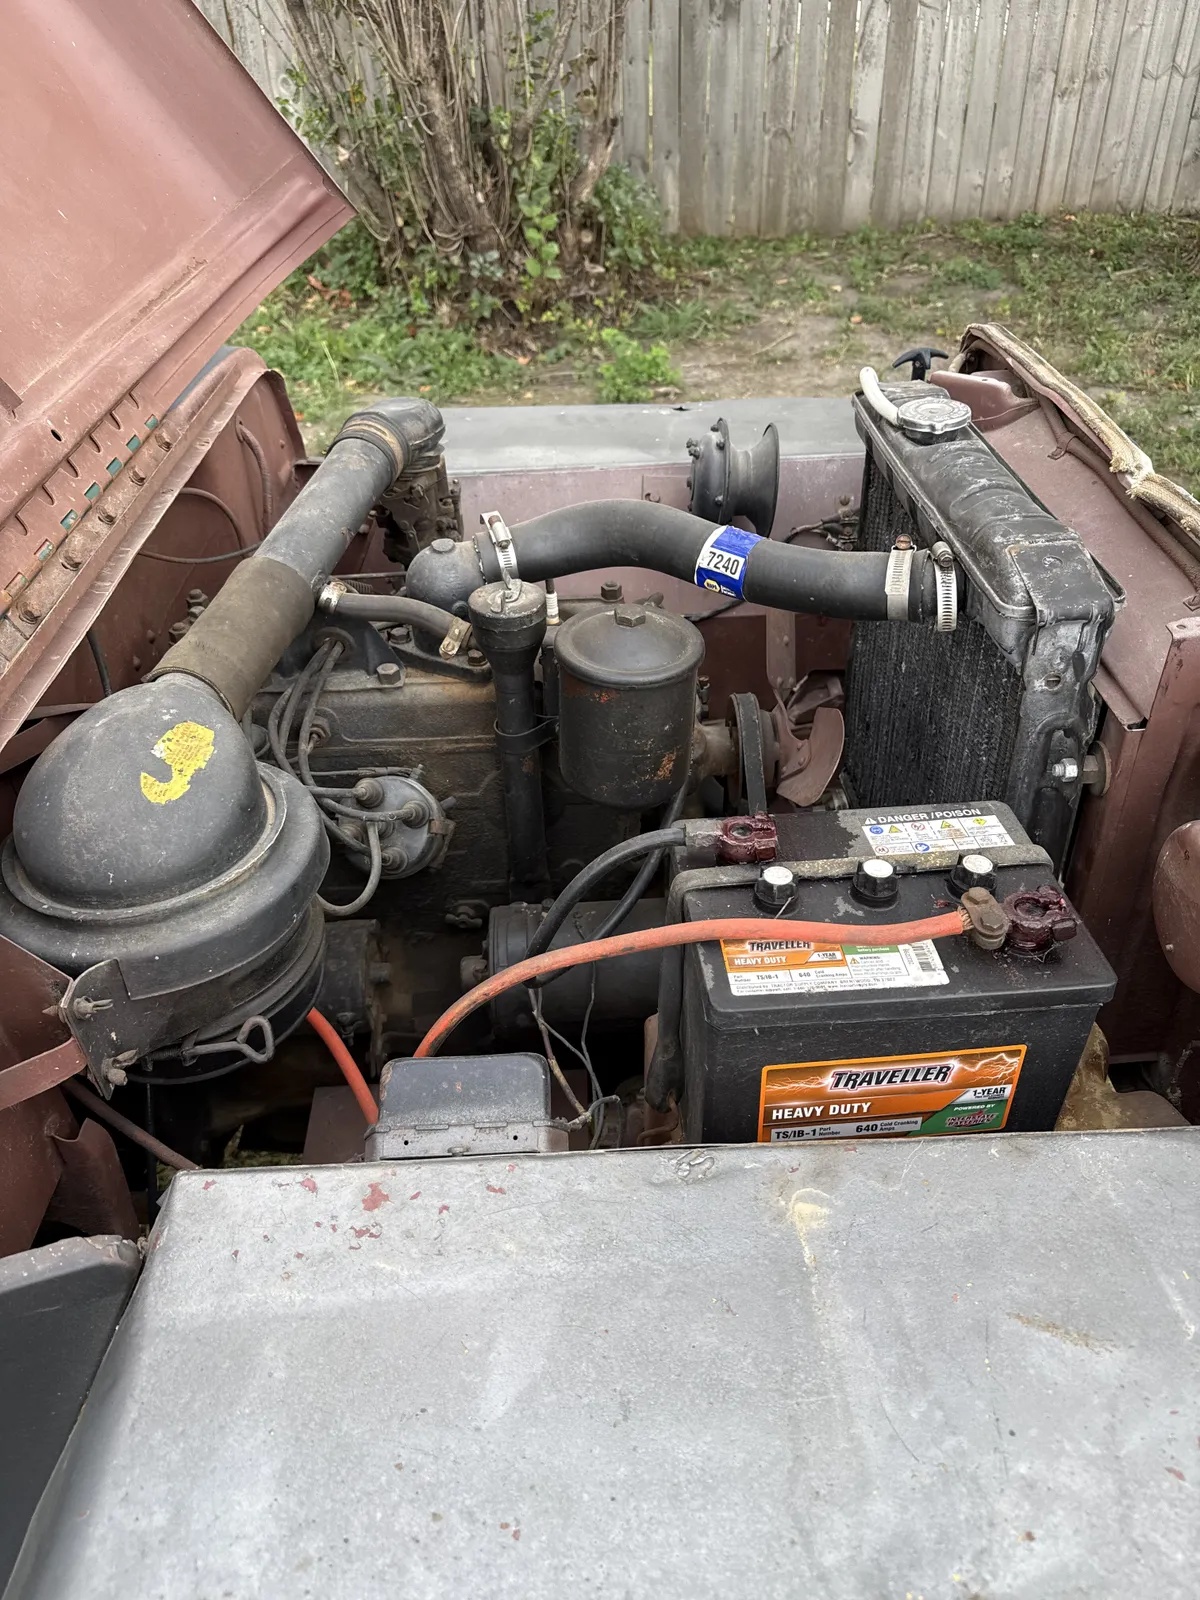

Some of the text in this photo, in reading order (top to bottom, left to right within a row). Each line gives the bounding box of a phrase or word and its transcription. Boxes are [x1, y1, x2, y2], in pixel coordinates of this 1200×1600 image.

[707, 551, 740, 576] 7240
[877, 812, 929, 824] DANGER
[936, 808, 982, 819] POISON
[748, 940, 812, 952] TRAVELLER
[734, 955, 787, 966] HEAVY DUTY
[832, 1064, 954, 1089] TRAVELLER
[973, 1087, 1006, 1097] 1-YEAR
[771, 1102, 872, 1120] HEAVY DUTY
[774, 1128, 817, 1140] TS/IB-1
[855, 1123, 878, 1133] 640
